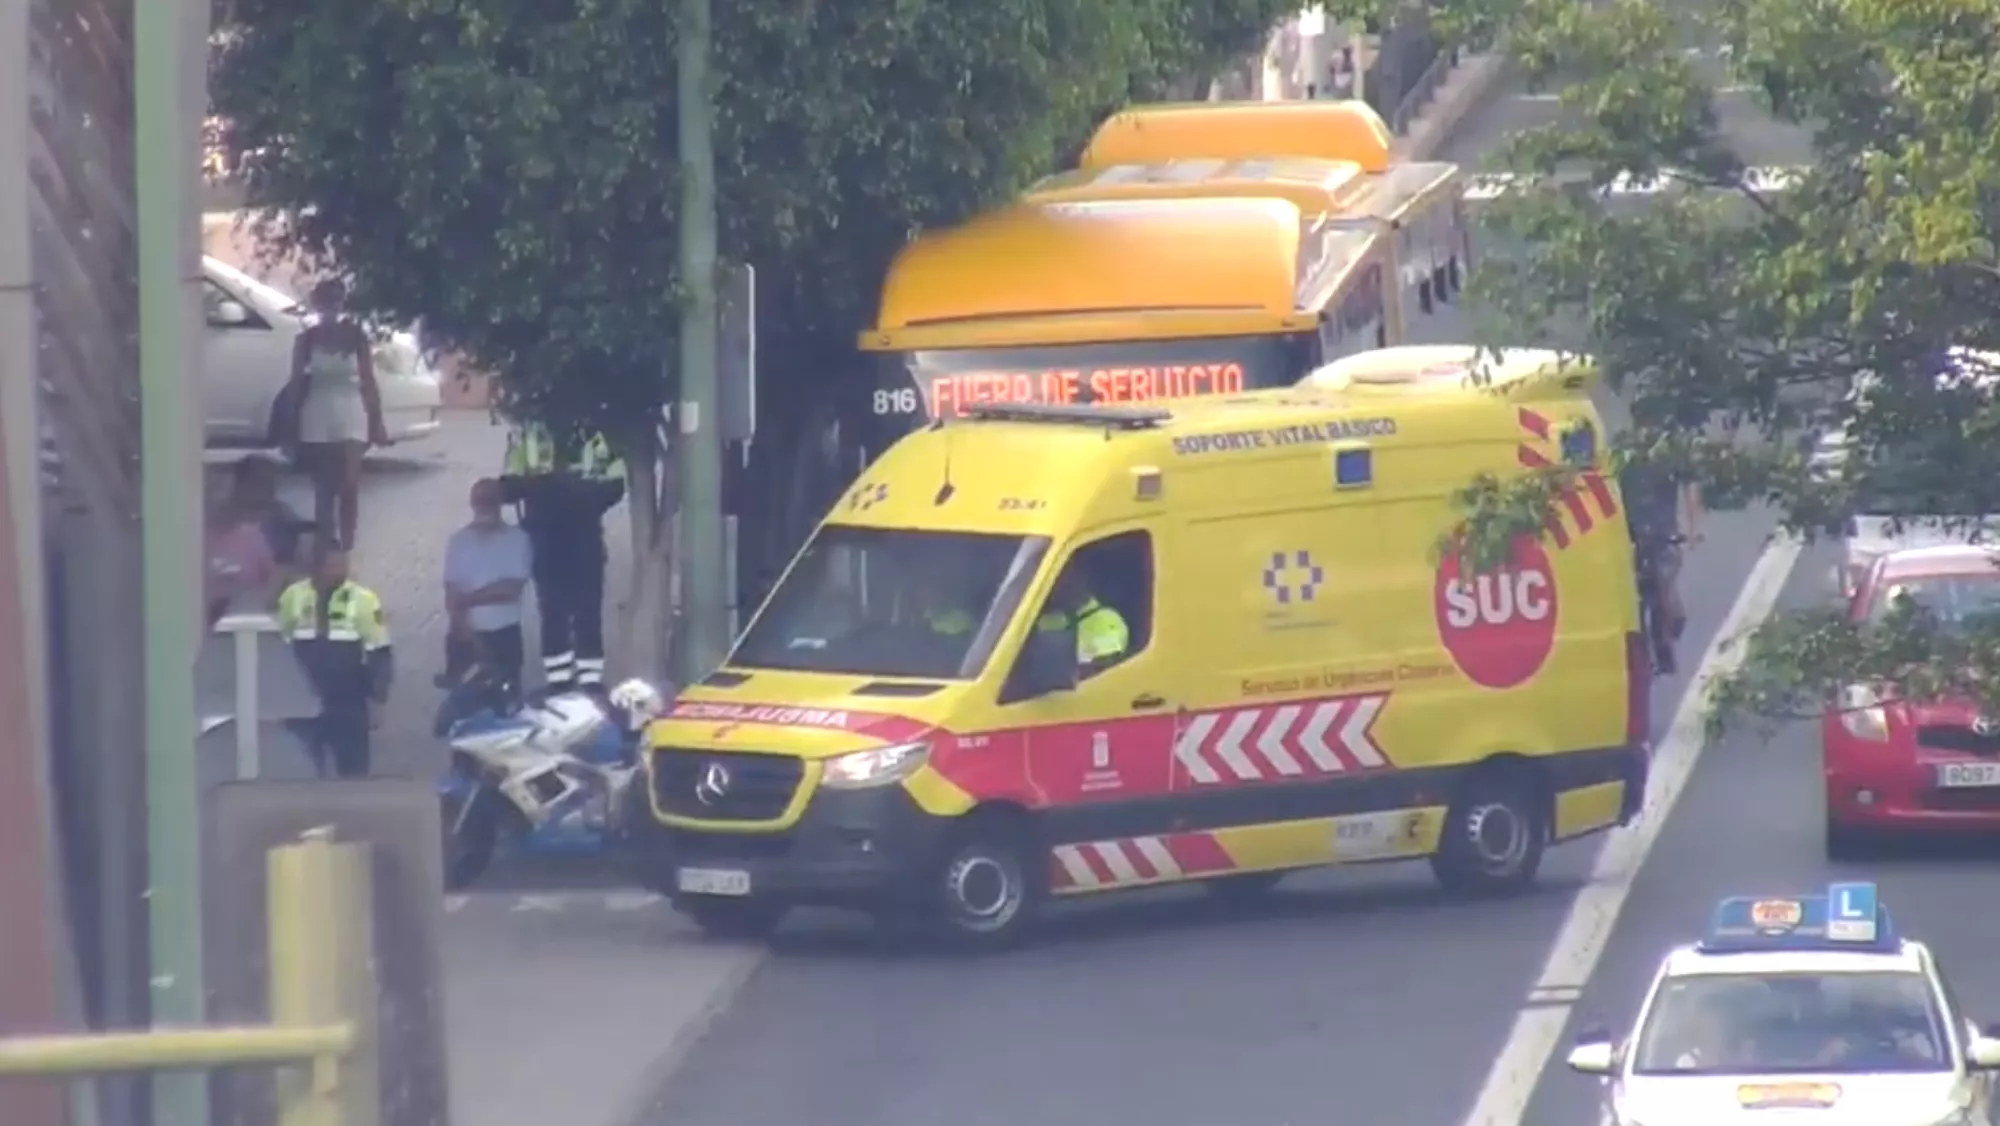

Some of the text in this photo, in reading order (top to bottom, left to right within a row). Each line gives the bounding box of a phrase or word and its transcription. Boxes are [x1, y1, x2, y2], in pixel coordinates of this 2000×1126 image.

[873, 390, 916, 415] 816
[1041, 371, 1079, 404] DE
[1172, 430, 1265, 455] SOPORTE
[1268, 424, 1325, 446] VITAL
[1446, 570, 1549, 629] SUC
[1841, 890, 1863, 917] L
